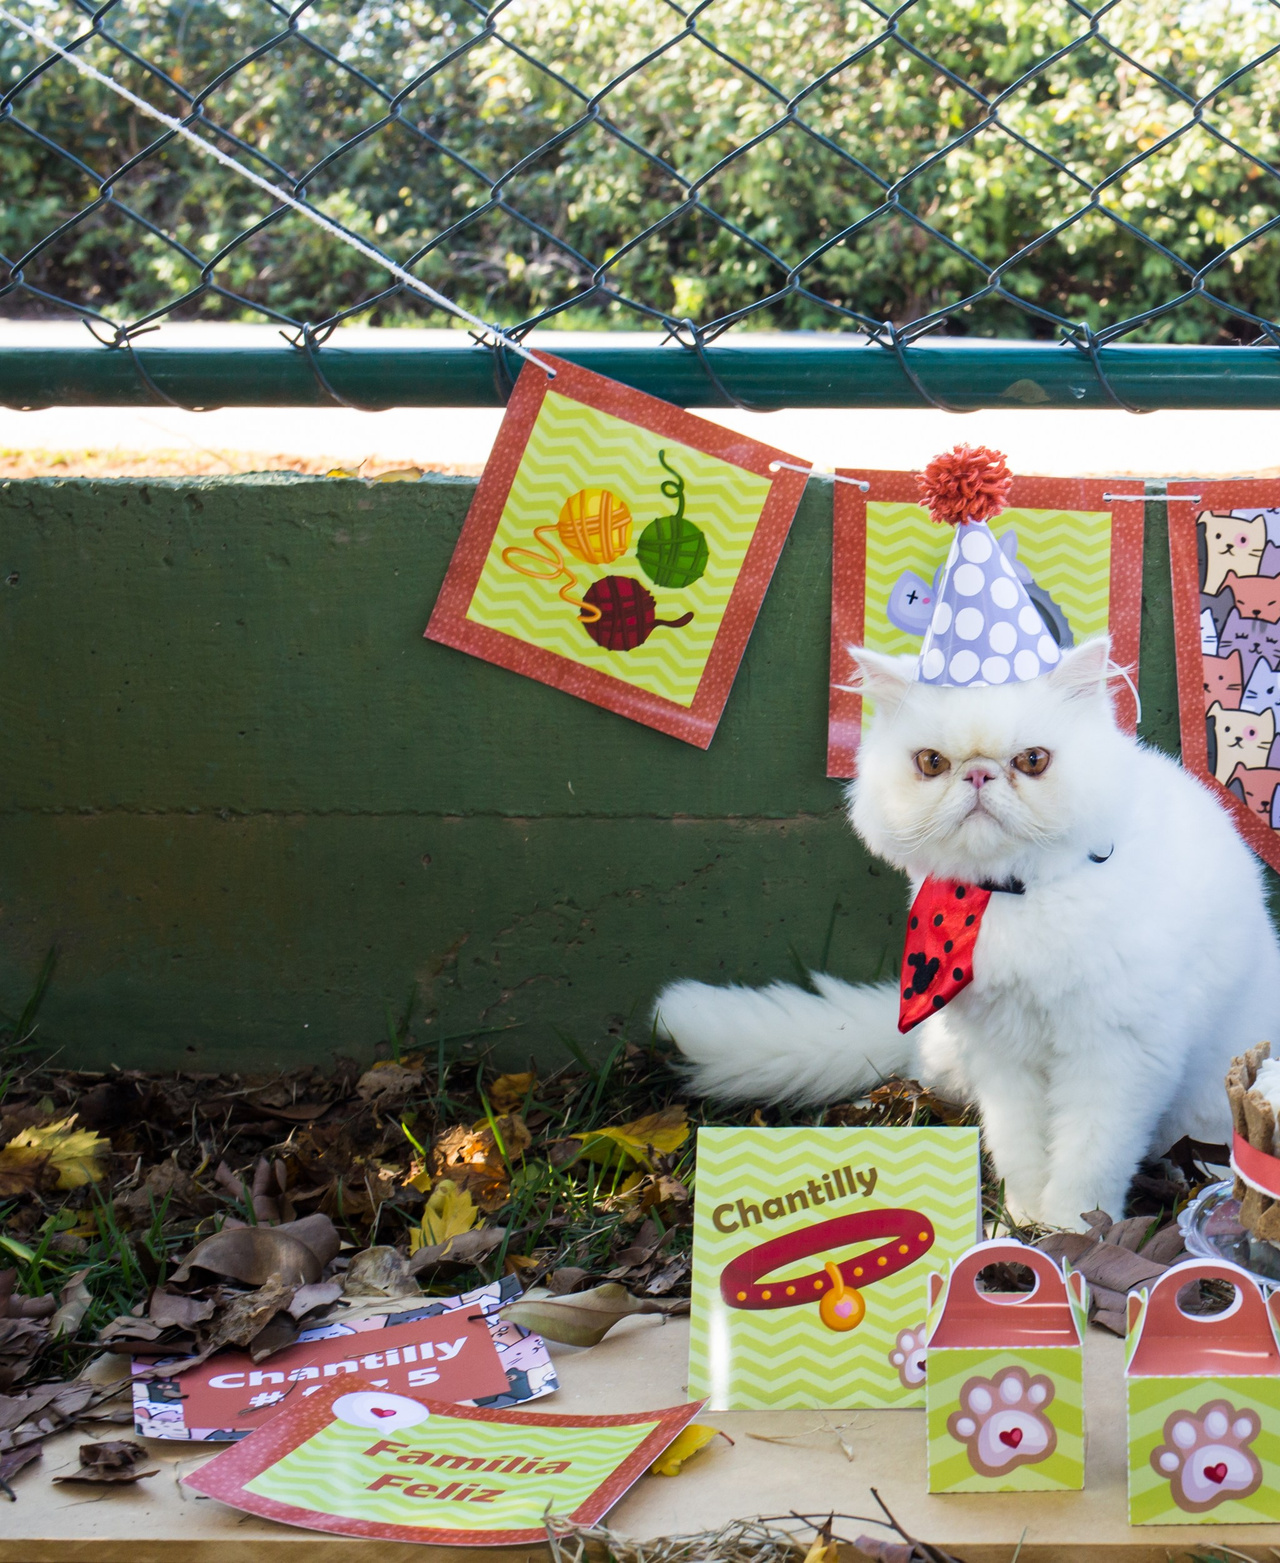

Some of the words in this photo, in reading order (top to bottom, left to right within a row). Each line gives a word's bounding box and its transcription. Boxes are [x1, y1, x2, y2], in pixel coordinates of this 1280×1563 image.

[712, 1165, 878, 1233] Chantilly
[208, 1336, 468, 1388] Chantilly
[362, 1440, 572, 1474] Família
[365, 1473, 506, 1503] Feliz
